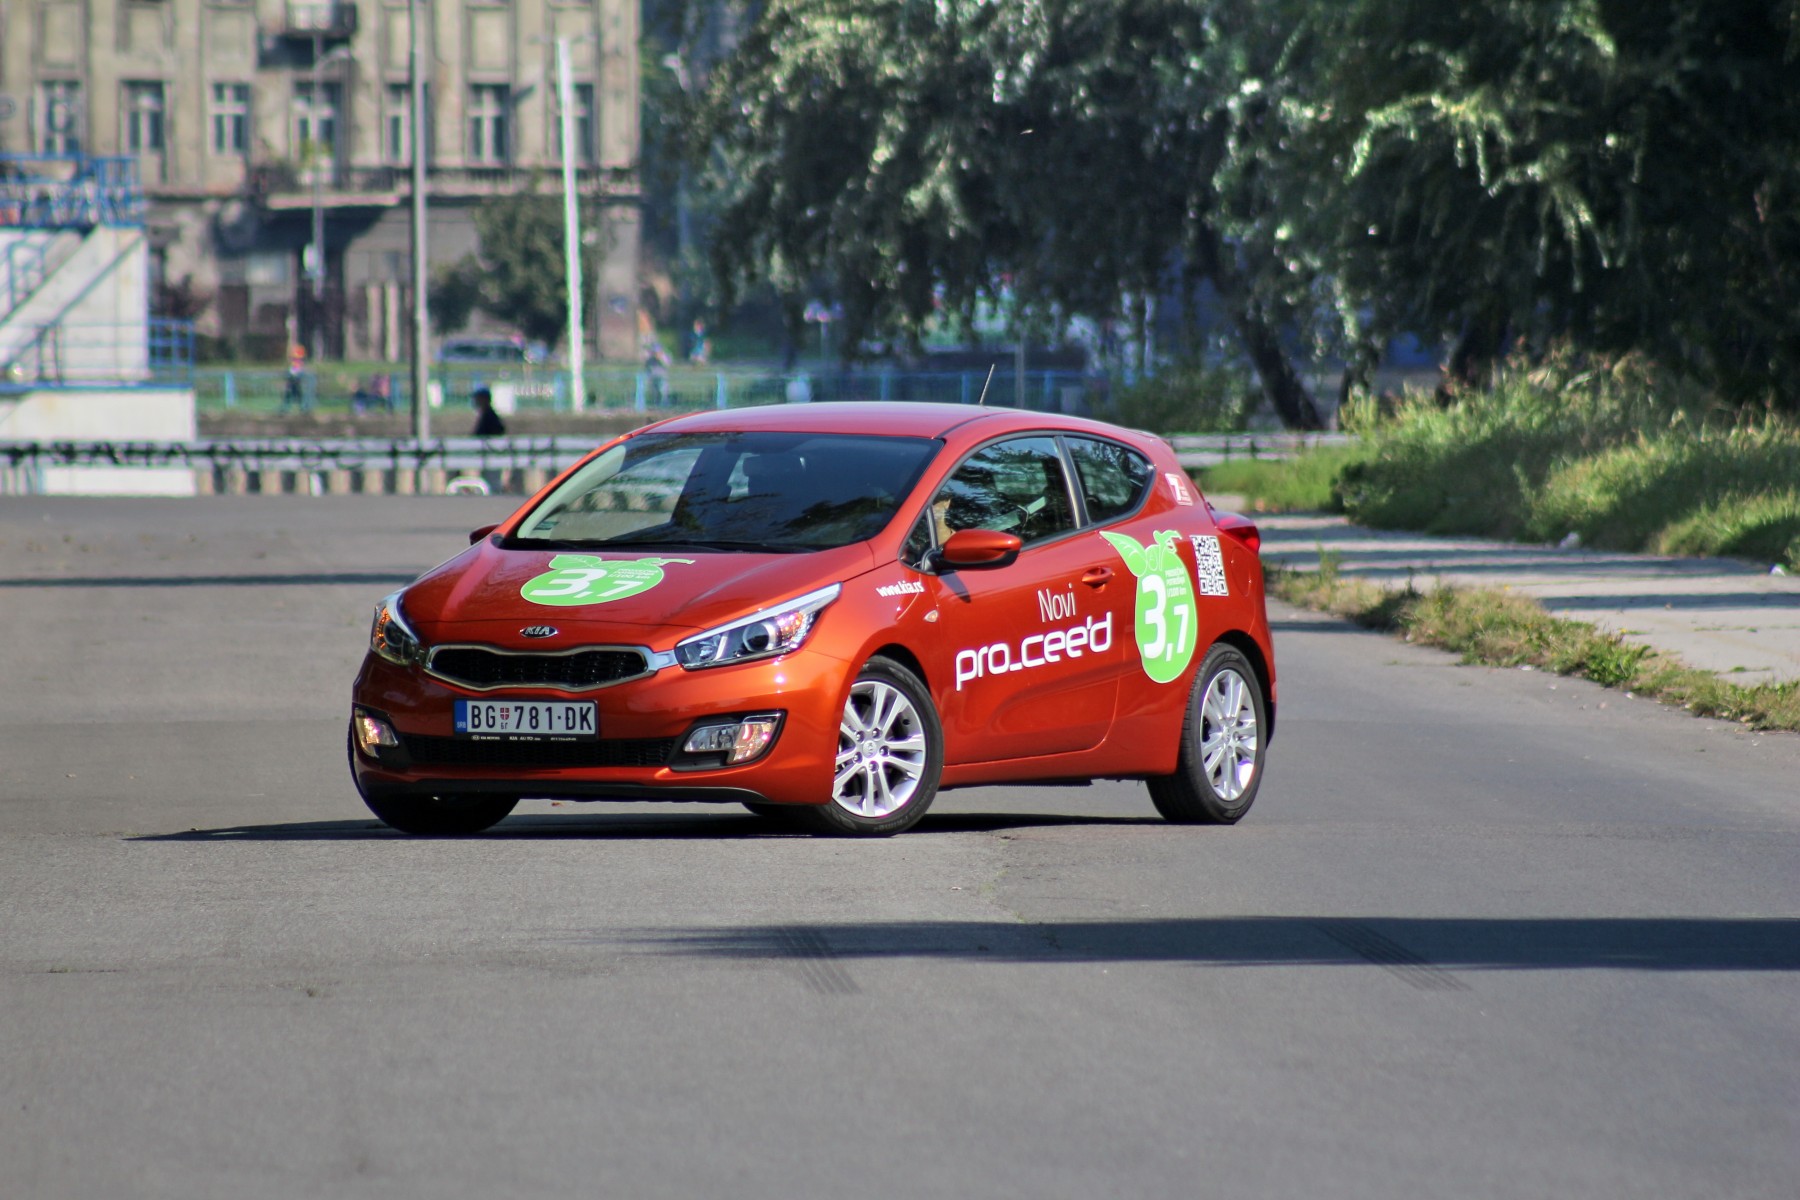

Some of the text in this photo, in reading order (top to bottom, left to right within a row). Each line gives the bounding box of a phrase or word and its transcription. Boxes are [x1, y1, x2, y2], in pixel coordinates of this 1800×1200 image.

[529, 568, 644, 599] 3,7
[875, 580, 925, 597] www.kia.rs
[1037, 582, 1076, 623] Novi
[525, 626, 550, 635] KIA
[1141, 574, 1190, 663] 3,7
[471, 705, 496, 729] BG
